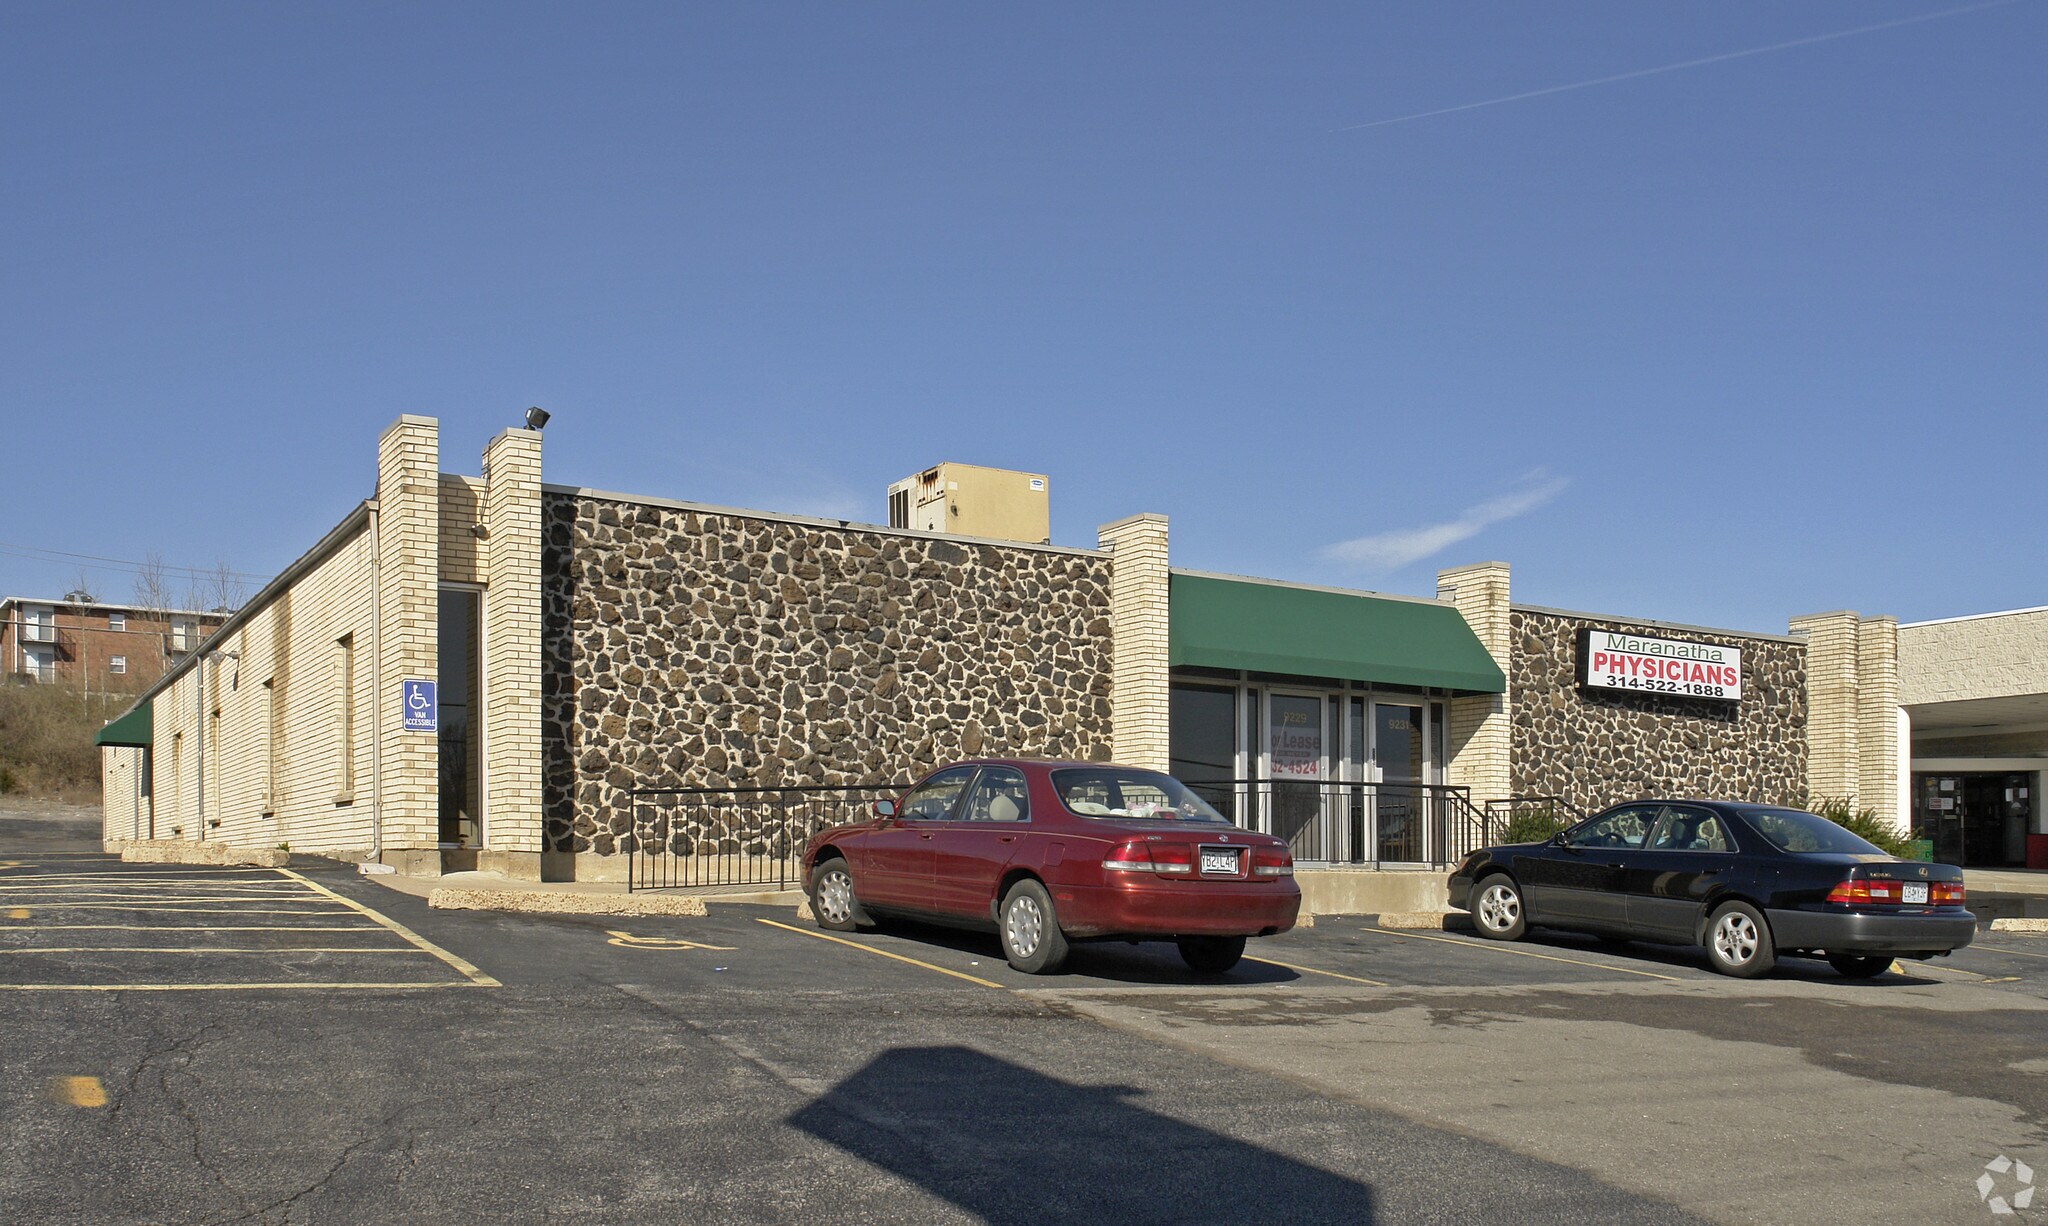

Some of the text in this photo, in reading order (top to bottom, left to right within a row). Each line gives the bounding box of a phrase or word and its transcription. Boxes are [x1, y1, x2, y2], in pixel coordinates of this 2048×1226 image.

[1607, 634, 1723, 661] Maranatha
[1594, 652, 1737, 687] PHYSICIANS
[1607, 675, 1724, 697] 314-522-1888
[405, 718, 436, 727] ACCESSIBLE
[1284, 711, 1306, 723] 9229
[1388, 719, 1410, 730] 9231
[1283, 731, 1319, 750] Lease
